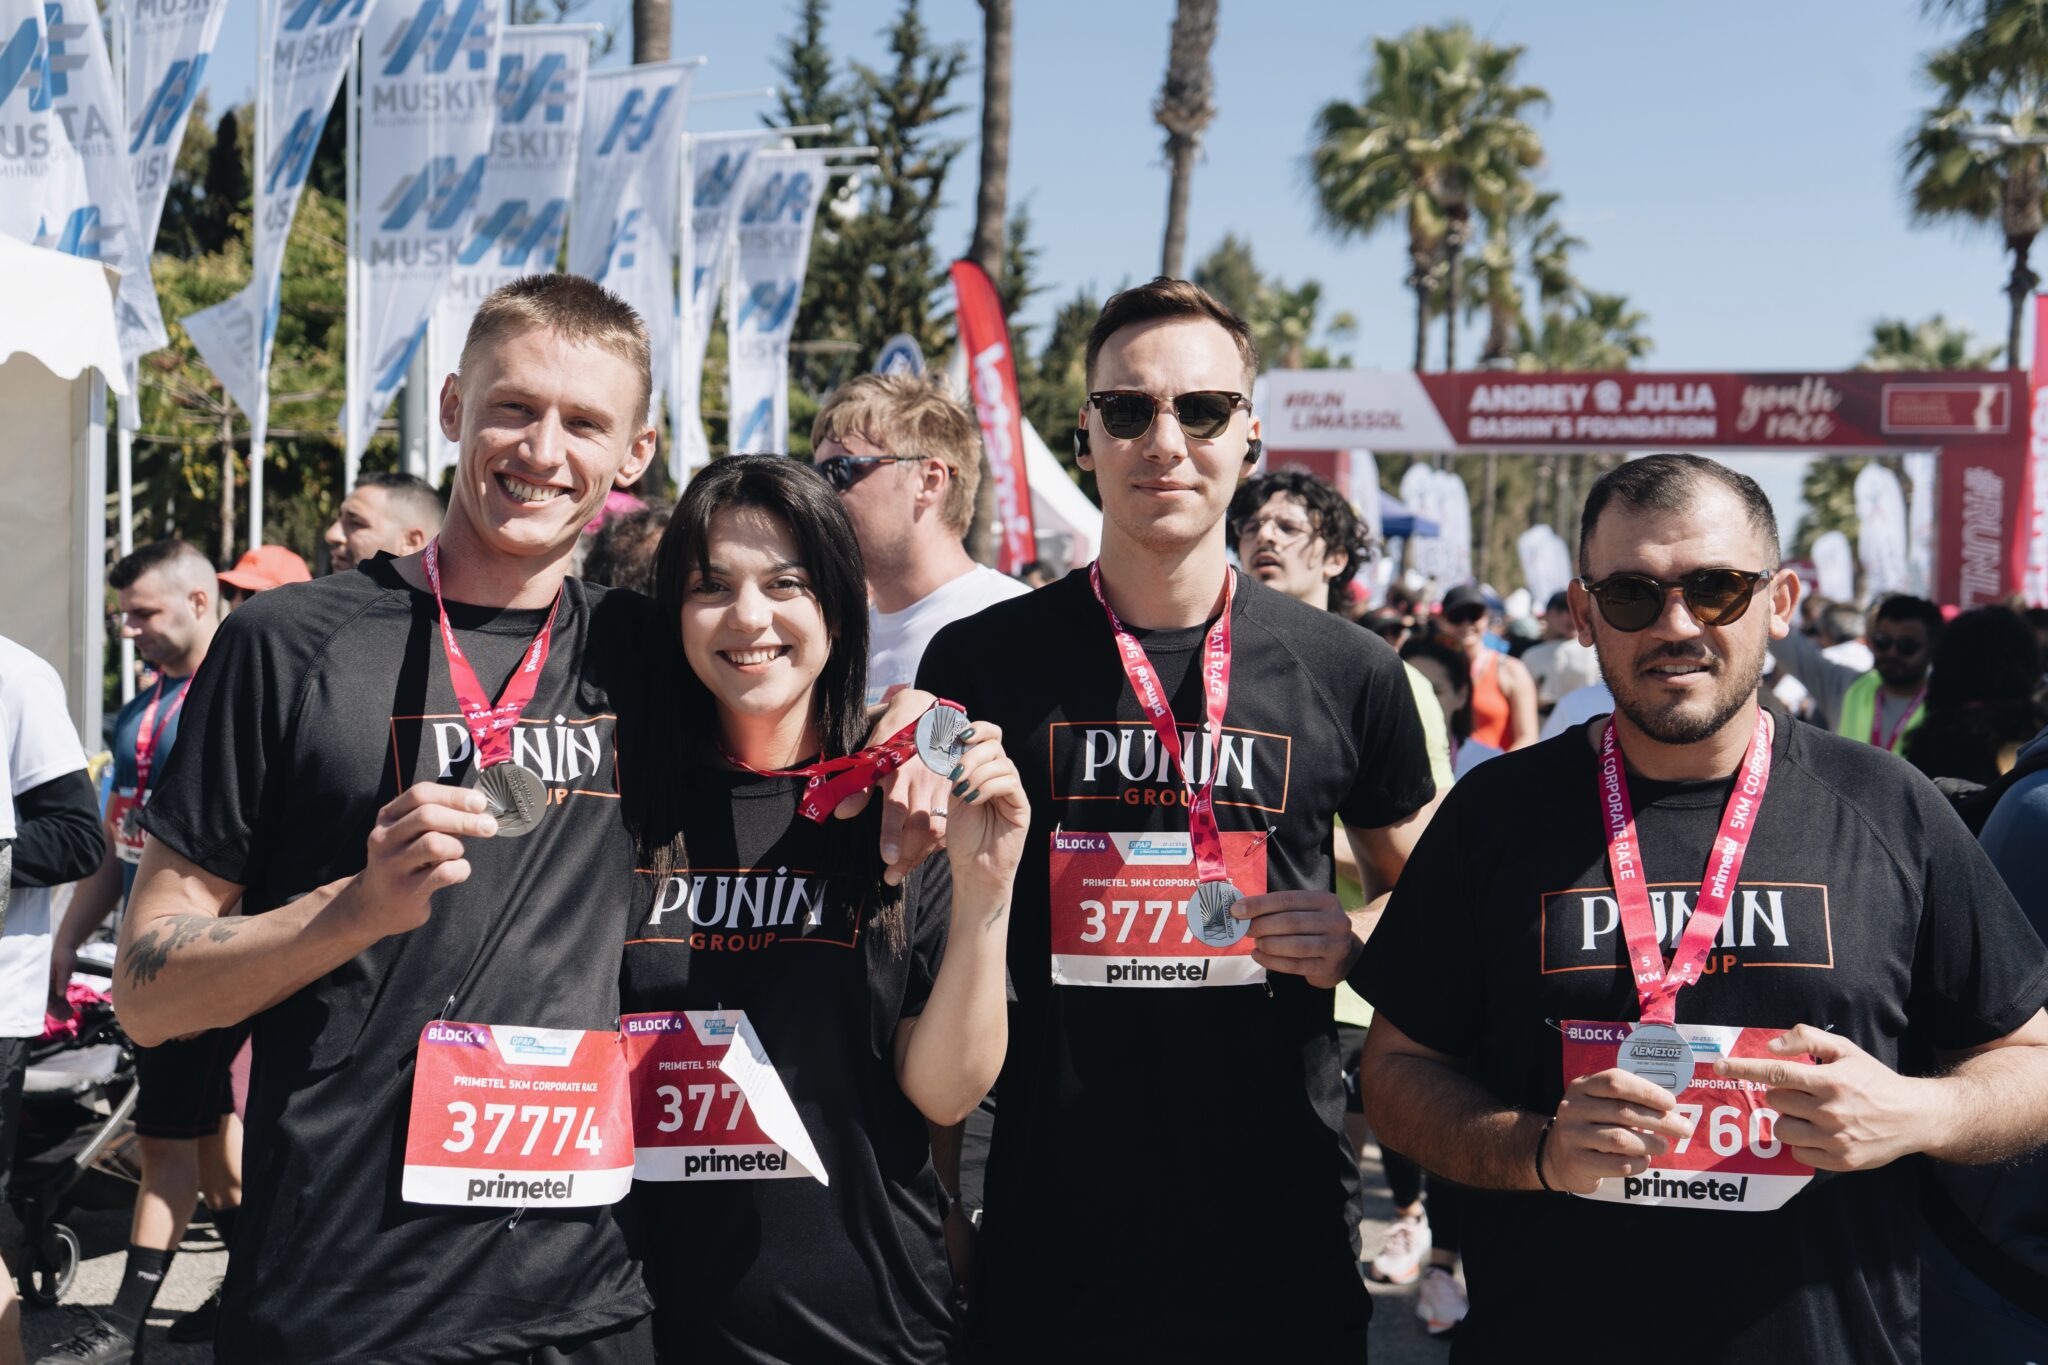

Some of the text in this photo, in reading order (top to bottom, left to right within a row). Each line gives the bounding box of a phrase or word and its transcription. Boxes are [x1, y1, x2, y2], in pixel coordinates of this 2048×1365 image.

[1469, 384, 1589, 412] ANDREY
[1626, 383, 1717, 412] JULIA
[1735, 376, 1842, 432] youth
[1291, 411, 1405, 432] LIMASSOL
[1576, 416, 1717, 438] FOUNDATION
[1210, 660, 1225, 698] RACE
[1603, 726, 1636, 881] 5KM CORPORATE RACE
[1710, 719, 1769, 899] primetel 5KM CORPORATE
[1056, 839, 1106, 850] BLOCK 4
[1082, 878, 1128, 887] PRIMETEL
[1130, 878, 1151, 887] 5KM
[648, 866, 829, 929] PUNIN
[689, 932, 777, 953] GROUP
[1106, 958, 1211, 984] primetel
[1642, 956, 1651, 967] 5
[1637, 971, 1662, 985] KM
[628, 1018, 683, 1033] BLOCK 4
[1569, 1027, 1612, 1041] BLOCK
[1615, 1028, 1625, 1041] 4
[428, 1028, 487, 1045] BLOCK 4
[1630, 1045, 1683, 1060] ΛΕΜΕΣΟΣ
[658, 1060, 705, 1072] PRIMETEL
[453, 1075, 599, 1093] PRIMETEL 5KM CORPORATE RACE
[441, 1101, 604, 1157] 37774
[684, 1147, 789, 1178] primetel
[466, 1172, 575, 1202] primetel
[1623, 1171, 1749, 1203] primetel
